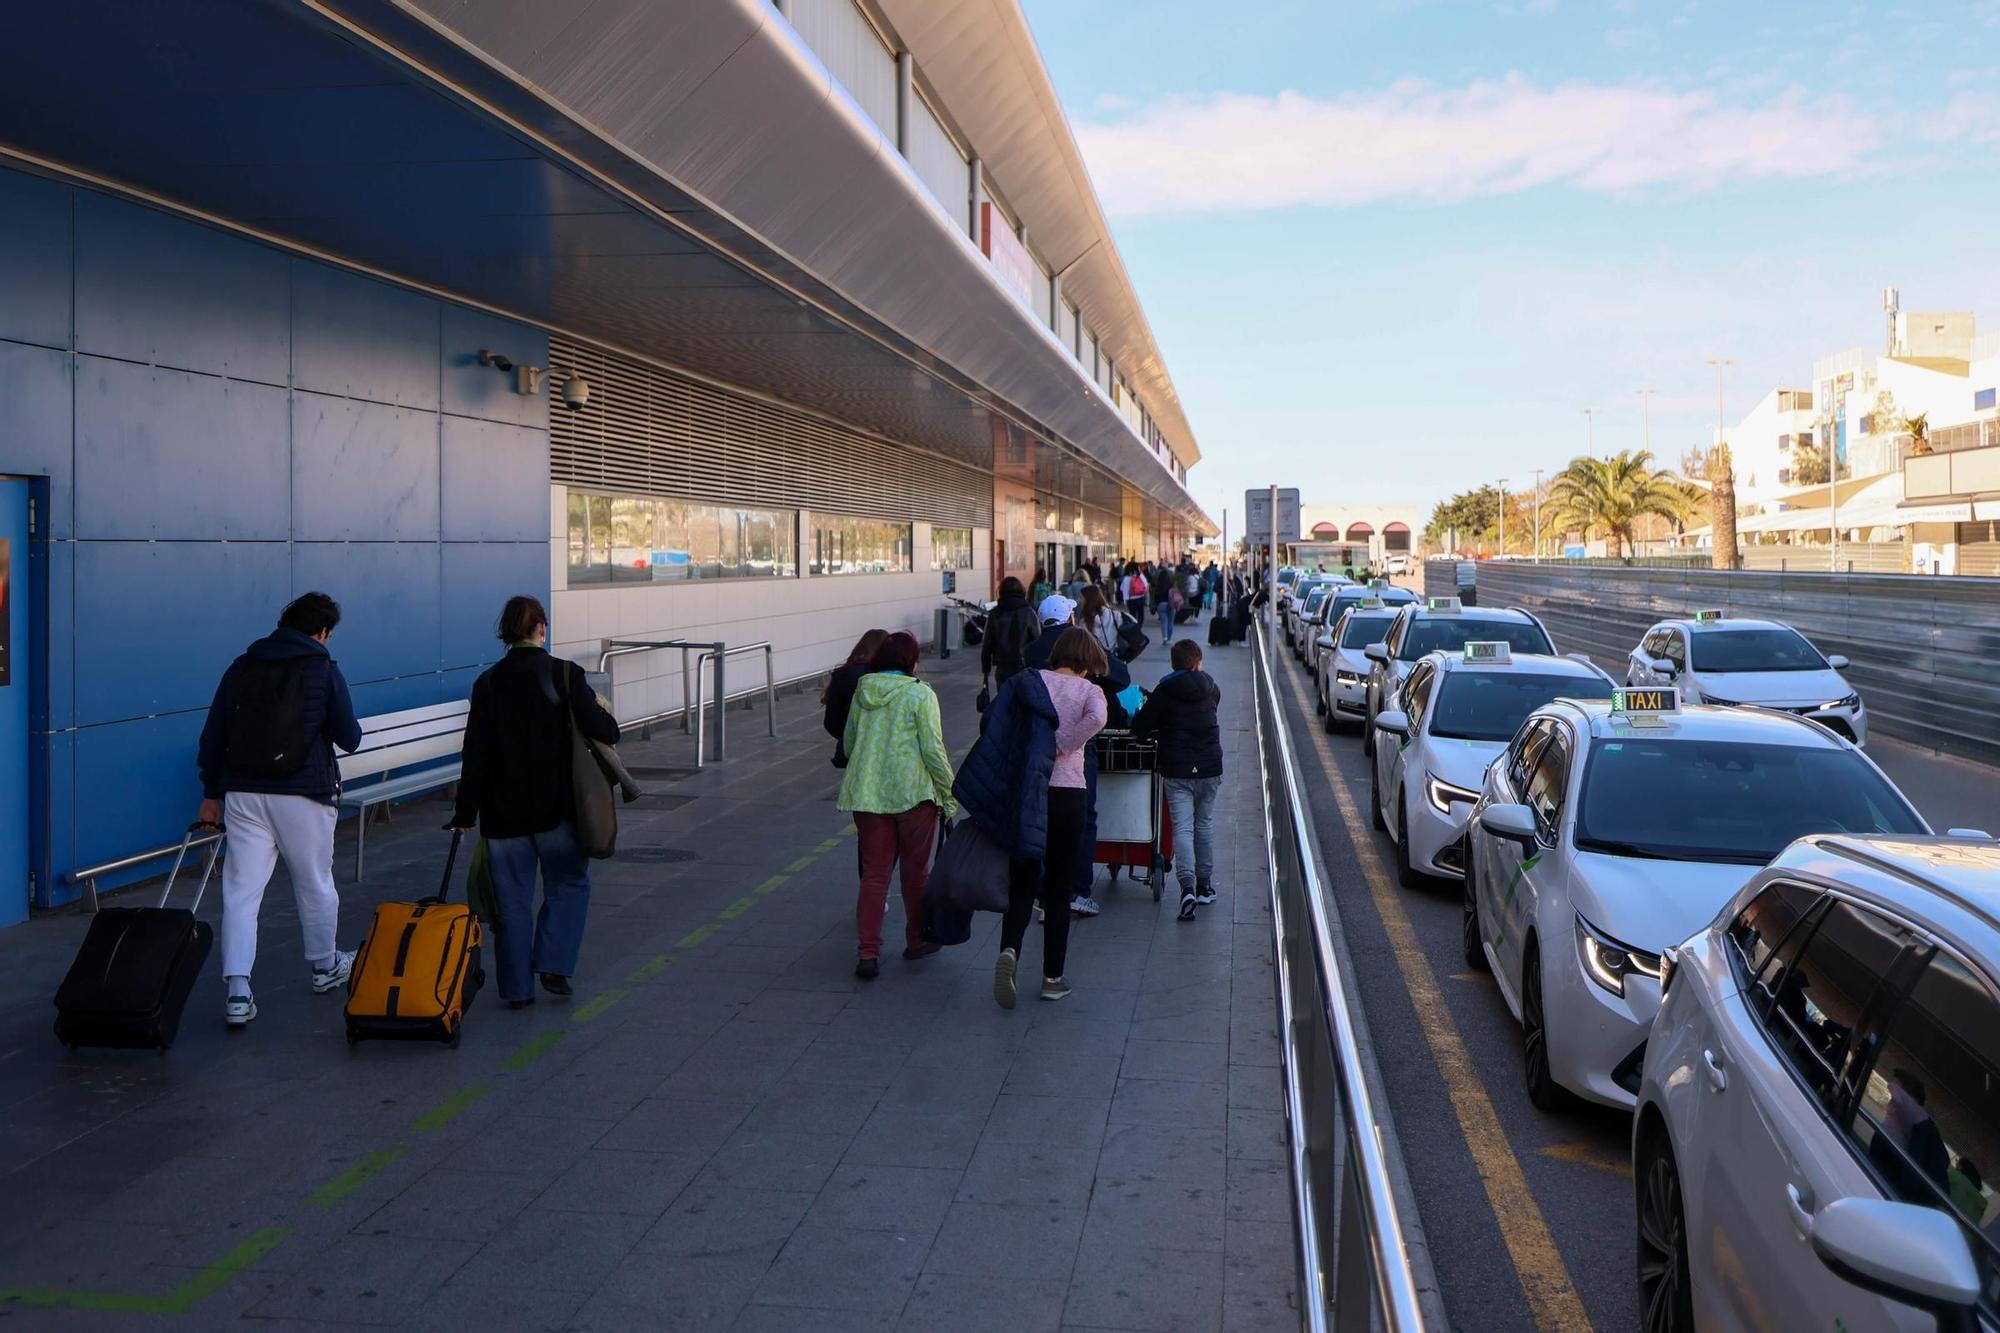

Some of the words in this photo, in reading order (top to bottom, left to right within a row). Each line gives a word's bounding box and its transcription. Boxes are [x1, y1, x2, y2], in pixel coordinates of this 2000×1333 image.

[1703, 611, 1716, 619] TAXI
[1474, 644, 1496, 657] TAXI
[1627, 692, 1661, 709] TAXI
